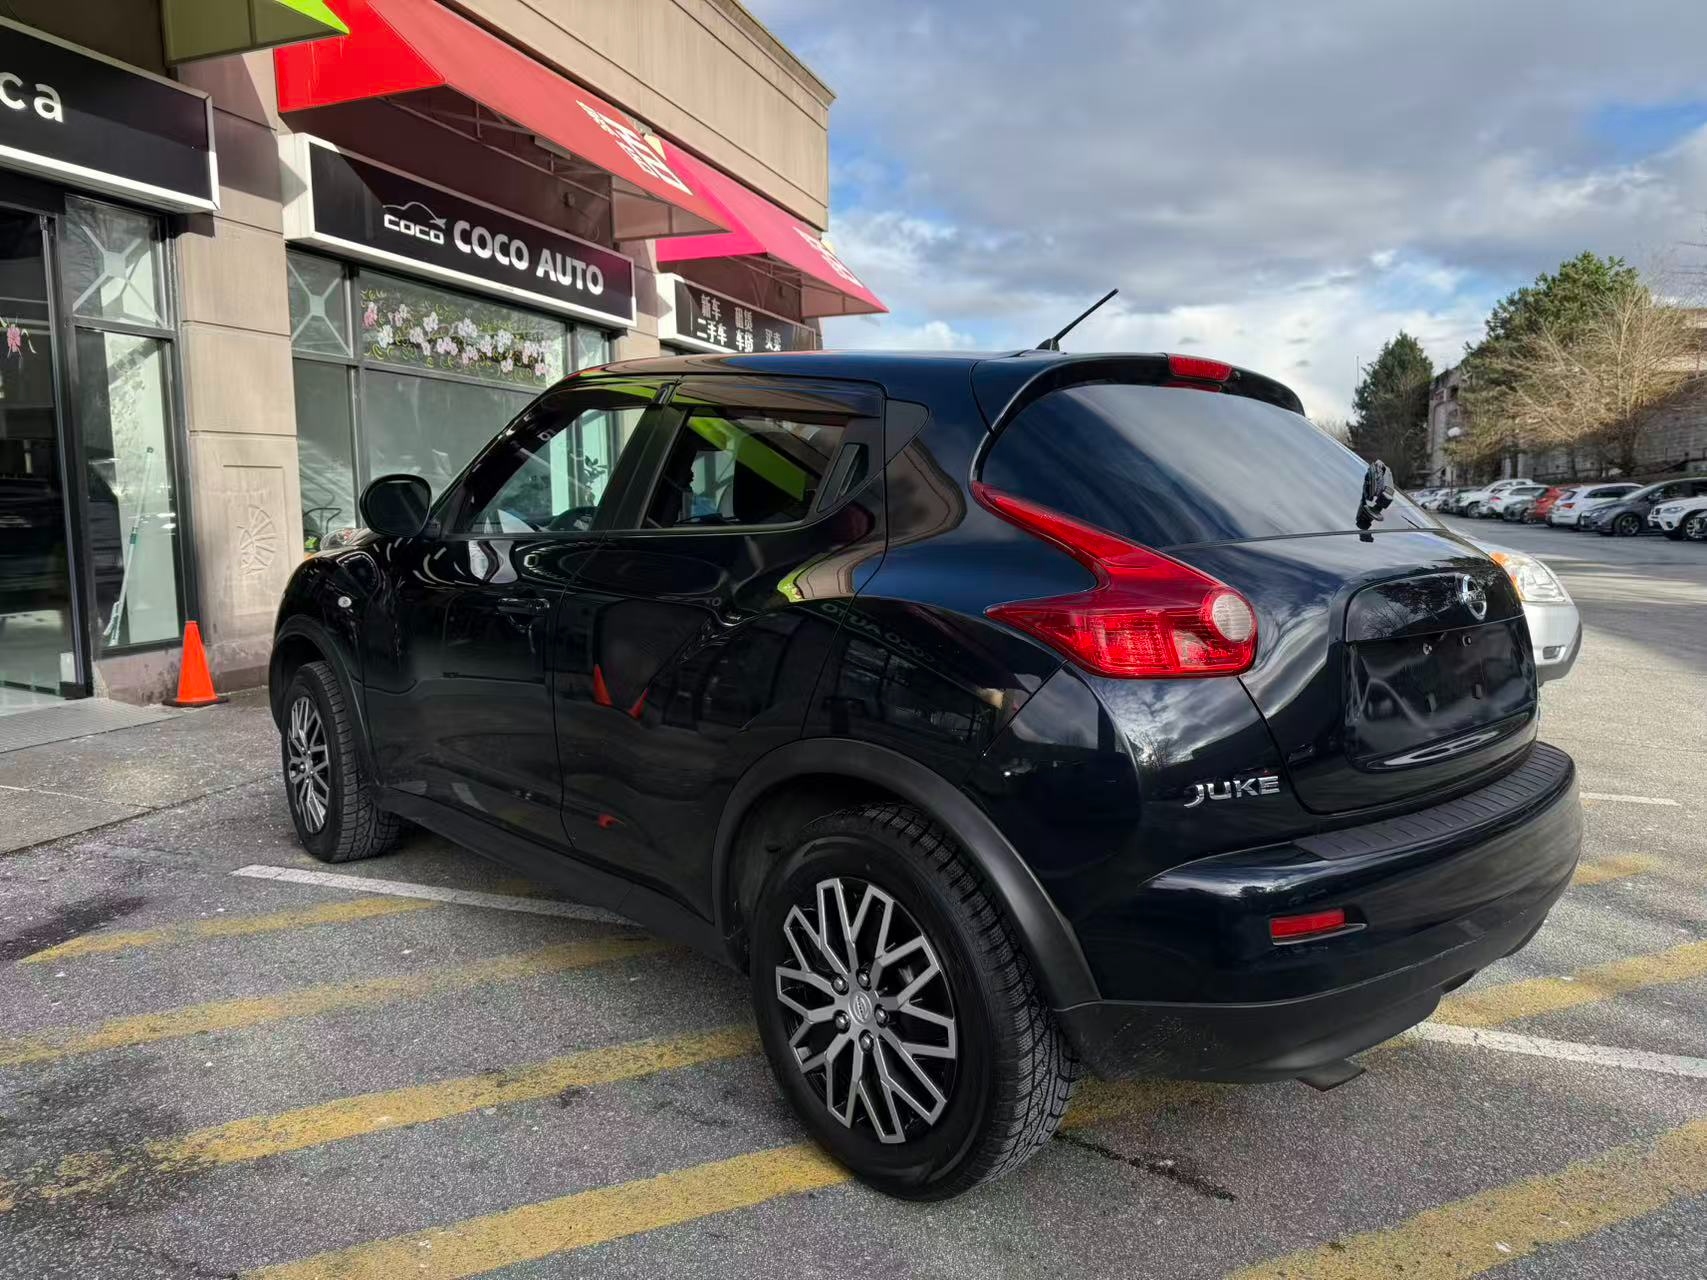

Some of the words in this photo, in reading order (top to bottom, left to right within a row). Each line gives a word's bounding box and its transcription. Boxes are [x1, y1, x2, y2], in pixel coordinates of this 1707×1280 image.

[383, 213, 445, 245] COCO
[453, 219, 530, 271] COCO
[535, 247, 605, 296] AUTO
[700, 294, 722, 321] 新车
[696, 317, 728, 346] 二手车
[1183, 774, 1280, 809] JUKE
